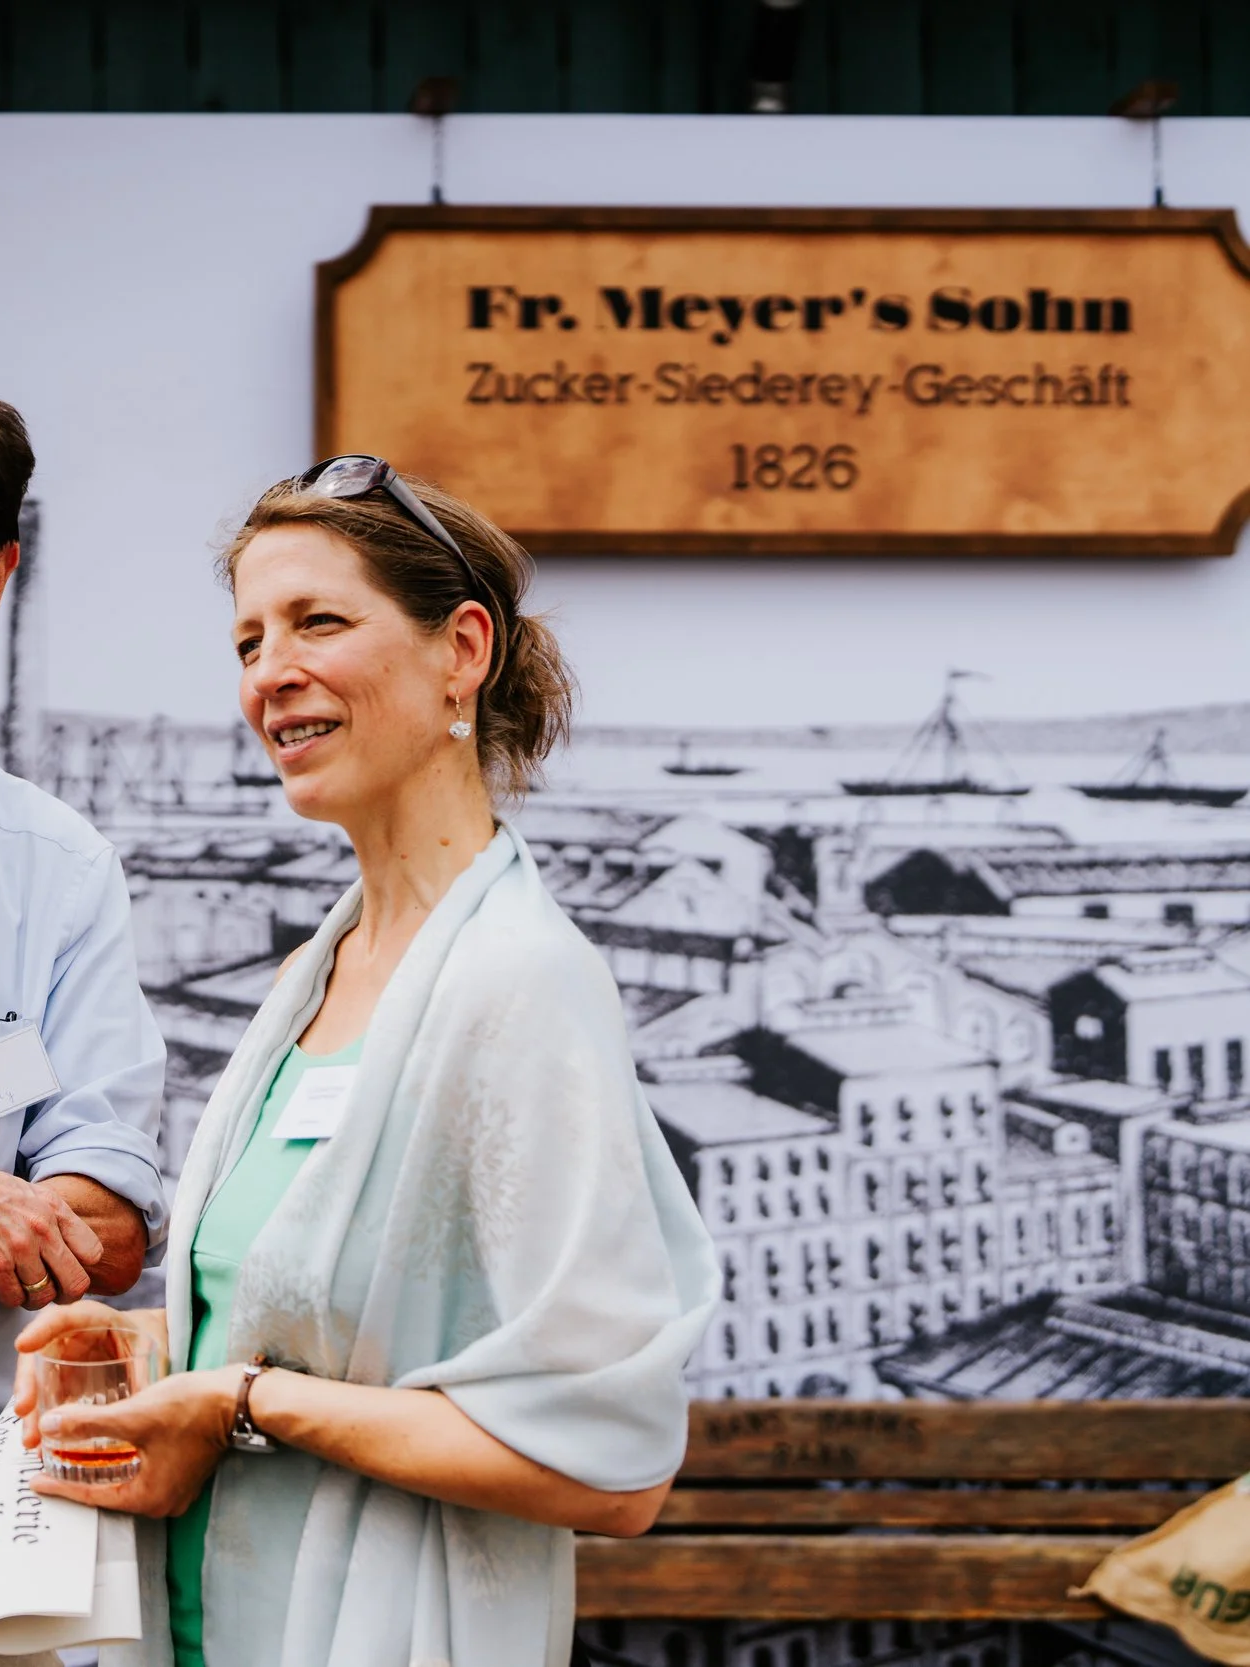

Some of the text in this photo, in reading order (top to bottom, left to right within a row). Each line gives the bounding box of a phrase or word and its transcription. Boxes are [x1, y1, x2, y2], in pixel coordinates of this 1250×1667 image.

[466, 286, 1132, 346] Fr. Meyer's Sohn
[730, 443, 860, 491] 1826
